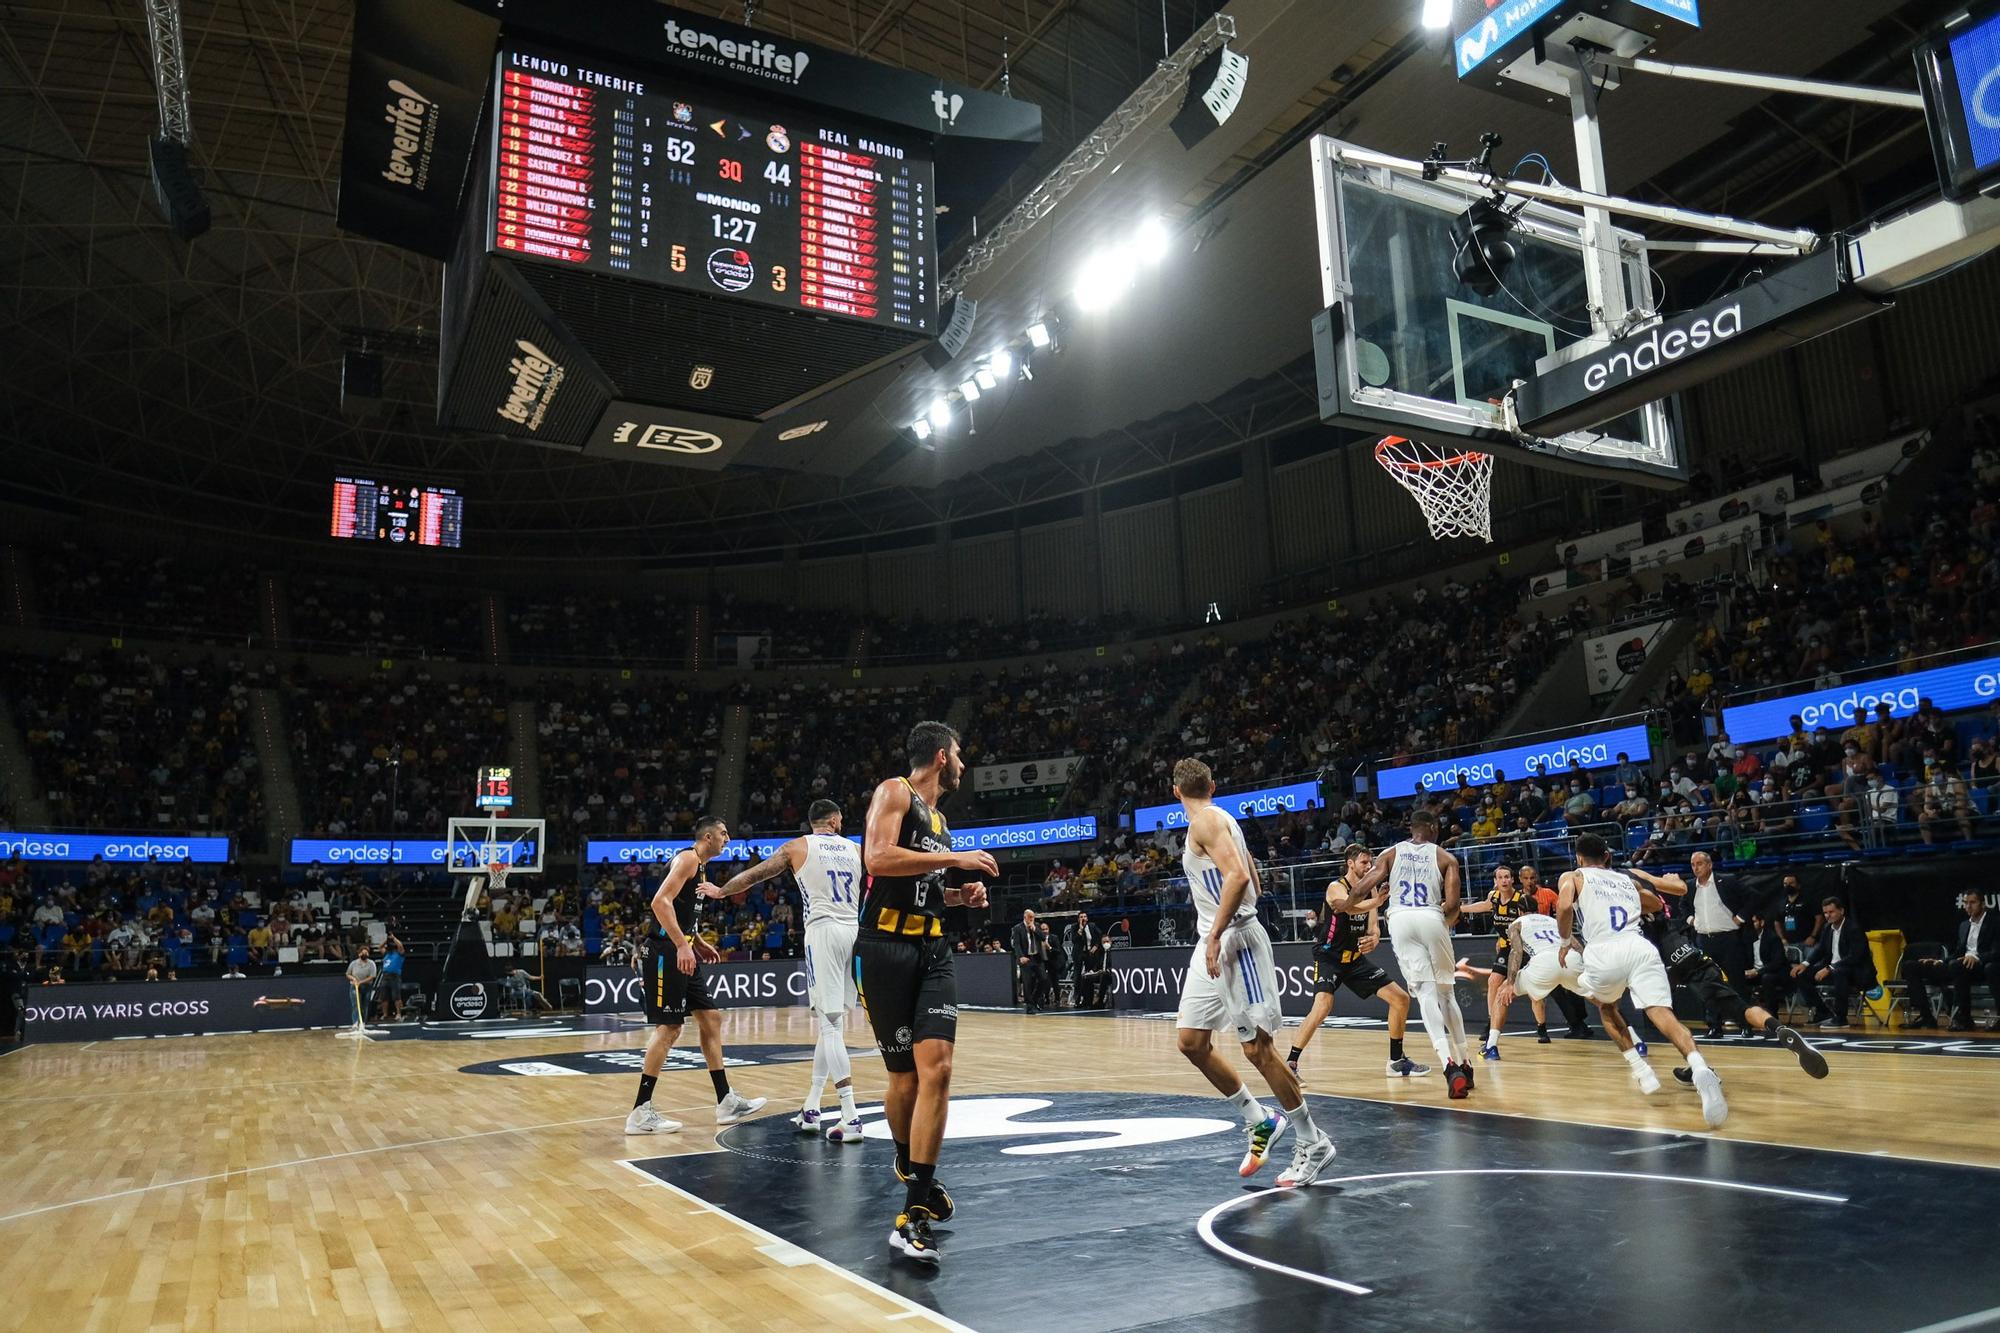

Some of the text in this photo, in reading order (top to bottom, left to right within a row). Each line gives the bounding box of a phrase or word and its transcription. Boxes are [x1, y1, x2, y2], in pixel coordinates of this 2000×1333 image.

[512, 52, 645, 96] LENOVO TENERIFE
[729, 61, 791, 84] emociones
[667, 136, 696, 166] 52
[819, 128, 904, 160] REAL MADRID
[763, 160, 791, 187] 44
[587, 198, 596, 209] E.
[707, 193, 761, 215] MONDO
[712, 213, 757, 244] 1:27
[670, 244, 687, 272] 5
[771, 265, 787, 292] 3
[1583, 303, 1743, 392] endesa
[1800, 687, 1920, 726] endesa
[1420, 743, 1607, 789] endesa endesa
[487, 781, 508, 796] 15
[1239, 794, 1295, 815] endesa
[0, 837, 189, 859] ndesa endesa
[981, 823, 1093, 846] endesa endesa
[328, 844, 402, 861] endesa
[826, 870, 853, 903] 17
[913, 880, 929, 907] 13
[1670, 943, 1692, 963] CICAR
[706, 974, 777, 1000] ARIS
[93, 1003, 143, 1019] YARIS
[148, 1000, 210, 1017] CROSS
